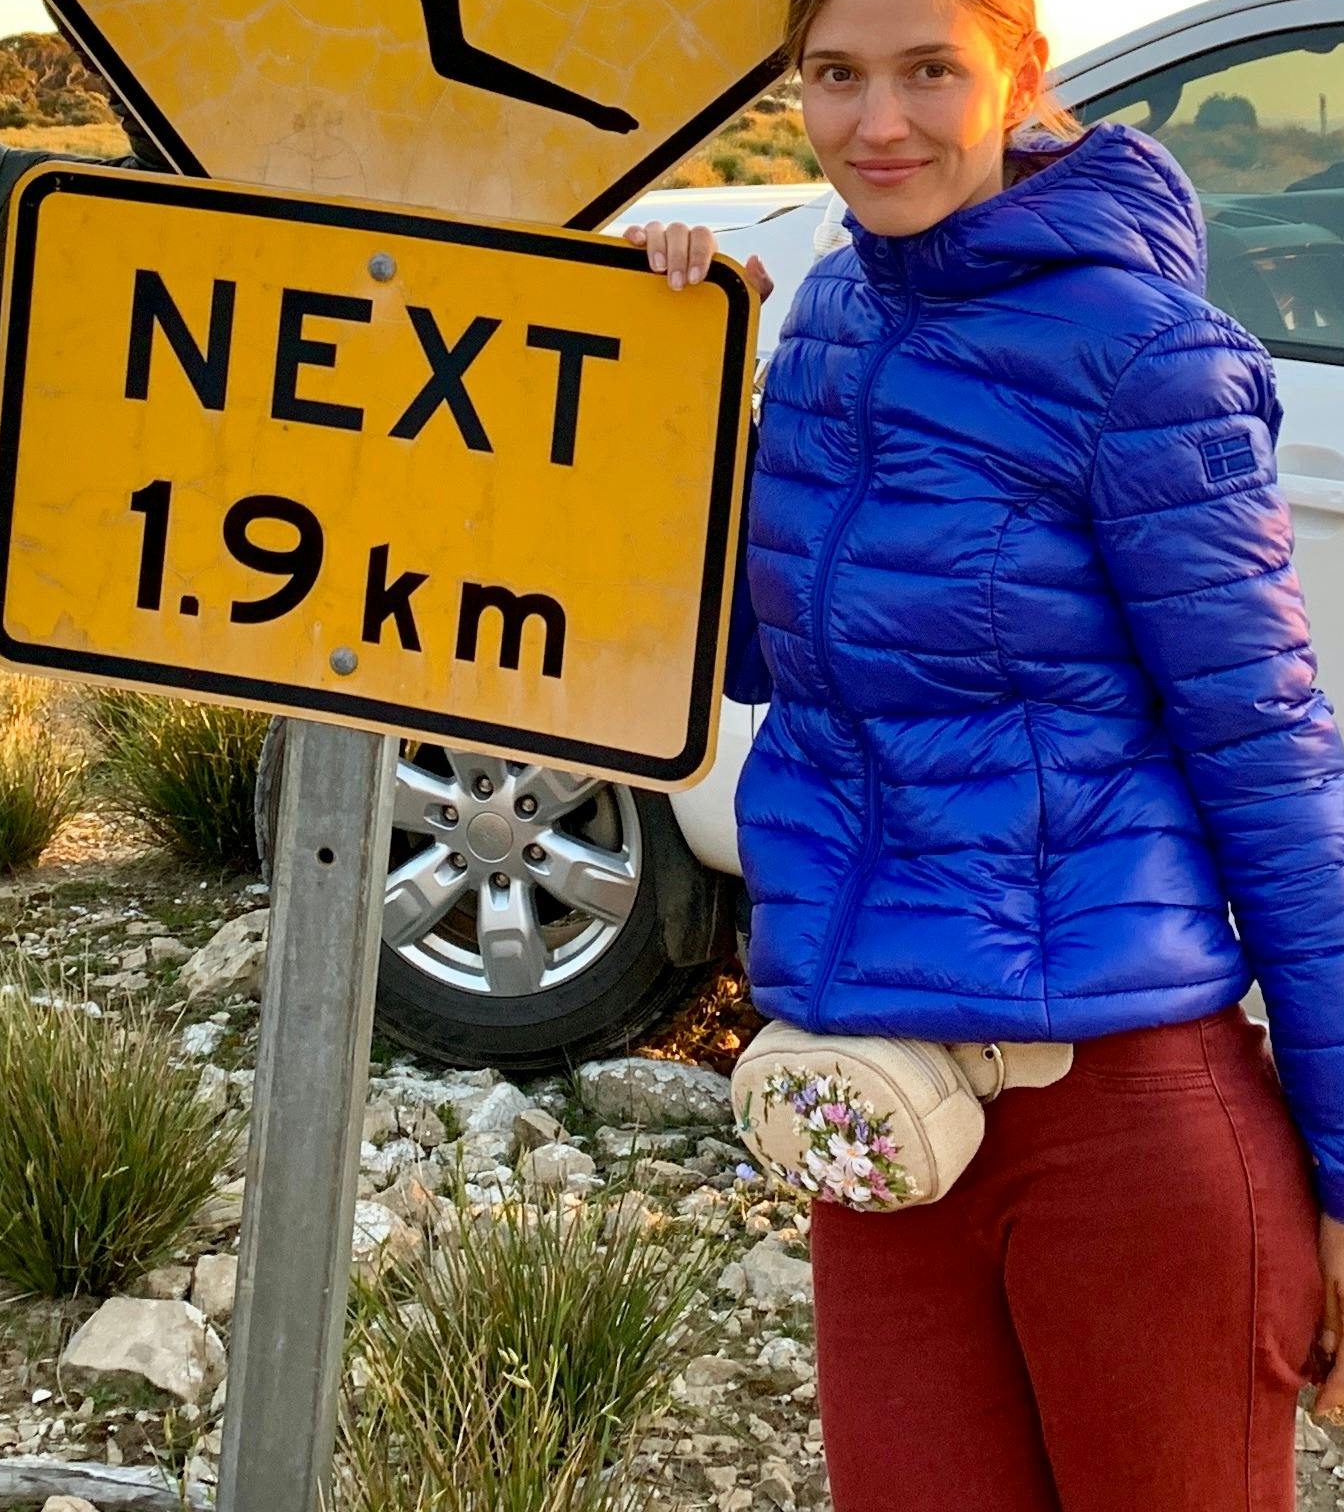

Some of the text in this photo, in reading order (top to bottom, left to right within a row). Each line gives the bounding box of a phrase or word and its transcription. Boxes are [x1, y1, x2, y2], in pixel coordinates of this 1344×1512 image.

[124, 268, 621, 467] NEXT
[130, 479, 566, 679] 1.9 km
